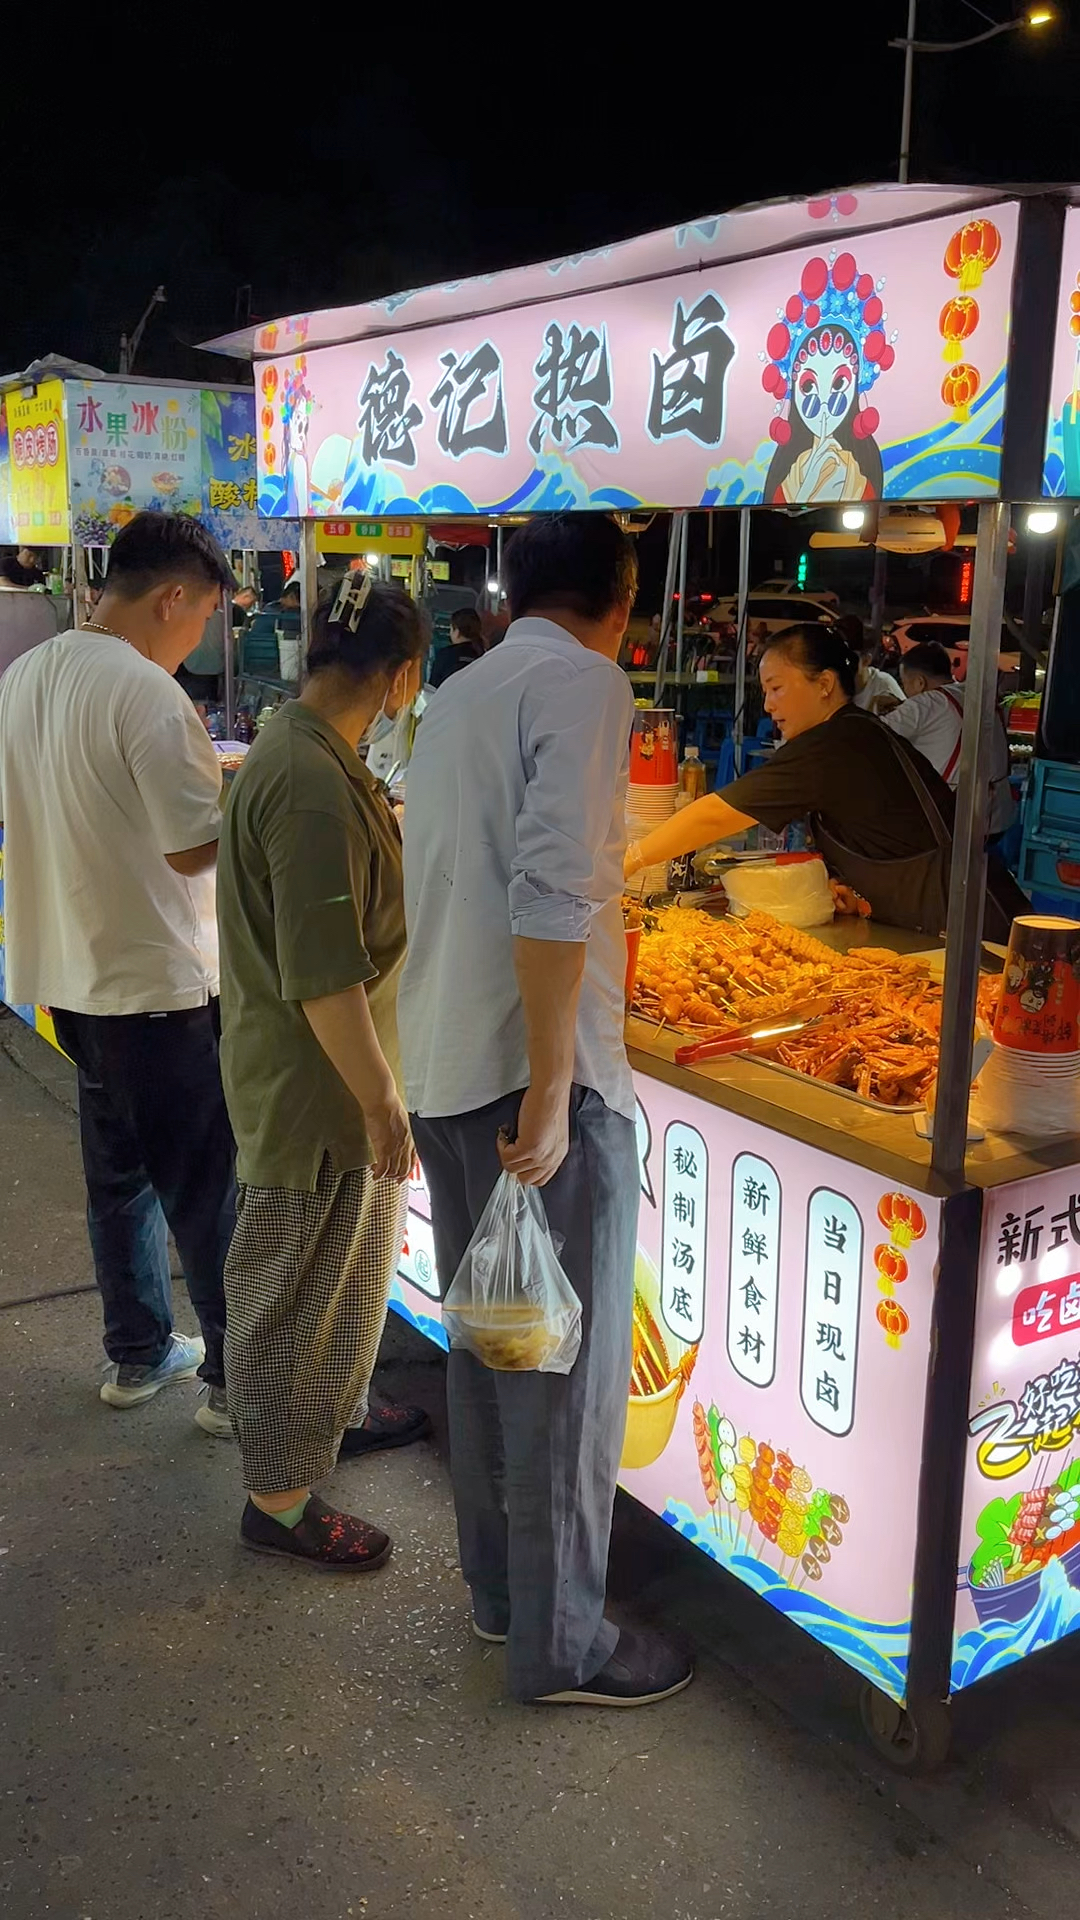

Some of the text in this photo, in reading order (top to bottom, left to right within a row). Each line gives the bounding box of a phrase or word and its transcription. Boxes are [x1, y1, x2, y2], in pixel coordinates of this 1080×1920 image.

[76, 396, 188, 451] 水果冰粉
[358, 294, 734, 467] 德记热卤
[670, 1146, 698, 1322] 秘制汤底
[737, 1176, 771, 1364] 新鲜食材
[815, 1215, 848, 1412] 当日现卤
